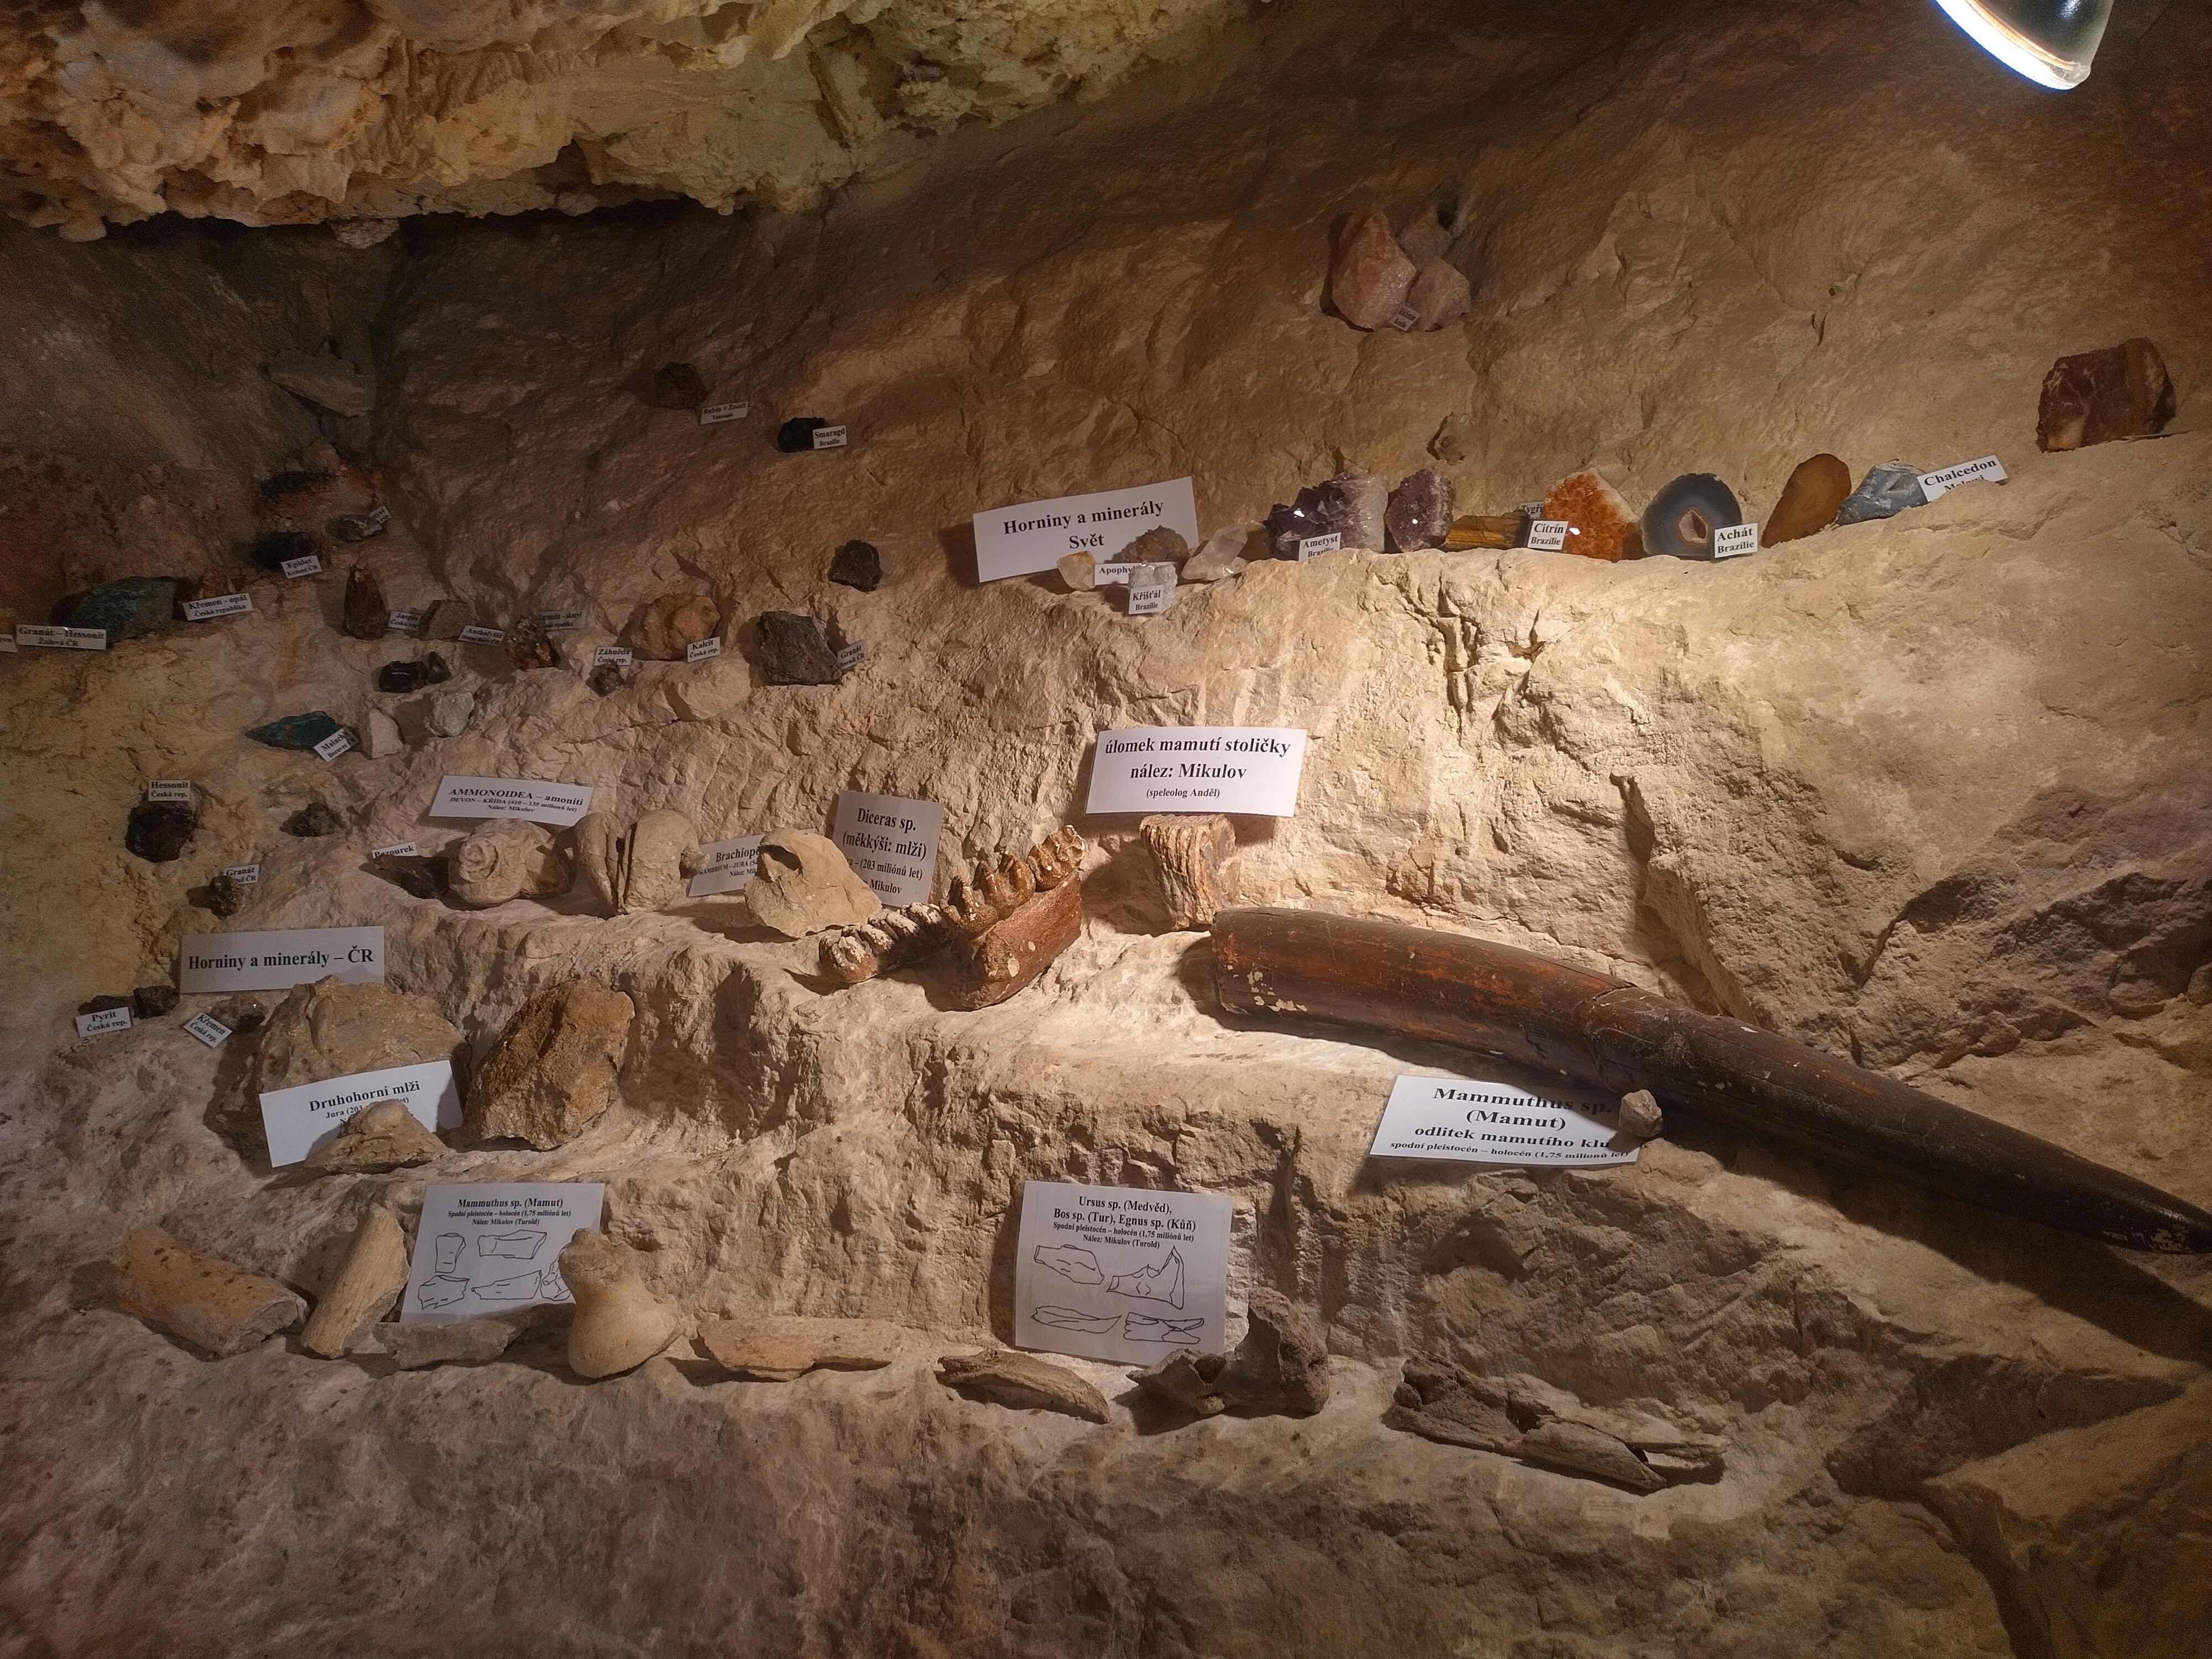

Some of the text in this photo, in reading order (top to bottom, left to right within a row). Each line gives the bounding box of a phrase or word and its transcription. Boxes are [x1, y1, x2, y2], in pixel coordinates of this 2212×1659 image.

[815, 427, 846, 439] Smaragd
[1924, 460, 1997, 486] Chalcedon
[1003, 500, 1164, 535] Horniny a minerály
[1534, 523, 1564, 534] Citrín
[1717, 527, 1753, 542] Achát
[1069, 533, 1105, 549] Svět
[1303, 535, 1338, 549] Ametyst
[1531, 536, 1561, 545] Brazílie
[1717, 541, 1755, 554] Brazílie
[1133, 589, 1161, 601] Křišťál
[189, 599, 222, 609] Křemen
[1135, 602, 1159, 611] Brazílie
[692, 640, 713, 650] Kalcit
[841, 645, 862, 659] Granát
[321, 730, 350, 752] Malachit
[1105, 736, 1291, 758] úlomek mamutí stoličky
[1130, 763, 1247, 779] nález: Mikulov
[449, 789, 533, 800] AMMONOIDEA
[545, 795, 584, 806] amoniti
[1146, 788, 1220, 799] (speleolog Anděl)
[857, 807, 916, 834] Diceras sp.
[842, 831, 927, 862] (měkkýši: mlži)
[226, 867, 255, 877] Granát
[860, 858, 876, 870] (203
[877, 862, 907, 877] miliónů
[909, 867, 924, 881] let)
[869, 878, 902, 895] Mikulov
[189, 954, 245, 971] Horniny
[251, 958, 258, 967] a
[263, 950, 330, 968] minerály
[348, 945, 374, 963] ČR
[91, 1011, 117, 1022] Pyrit
[87, 1021, 110, 1032] Česká
[197, 1014, 226, 1036] Křemen
[309, 1081, 421, 1112] Druhohorní mlži
[1432, 1087, 1612, 1115] Mammuthus sp.
[325, 1110, 345, 1119] Jura
[1466, 1109, 1567, 1131] (Mamut)
[1415, 1126, 1475, 1140] odlitek
[1480, 1133, 1574, 1147] mamutího
[1390, 1141, 1425, 1150] spodní
[1426, 1142, 1478, 1154] pleistocén
[1490, 1148, 1531, 1157] holocén
[457, 1198, 564, 1209] Mammuthus sp. (Mamut)
[1079, 1196, 1173, 1216] Ursus sp. (Medvěd),
[1054, 1208, 1196, 1233] Bos sp. (Tur), Egnus sp. (Kůň)
[1053, 1221, 1194, 1243] Spodní pleistocén holocén (1,75 miliónů let)
[1082, 1234, 1160, 1250] Nález: Mikulov (Turold)
